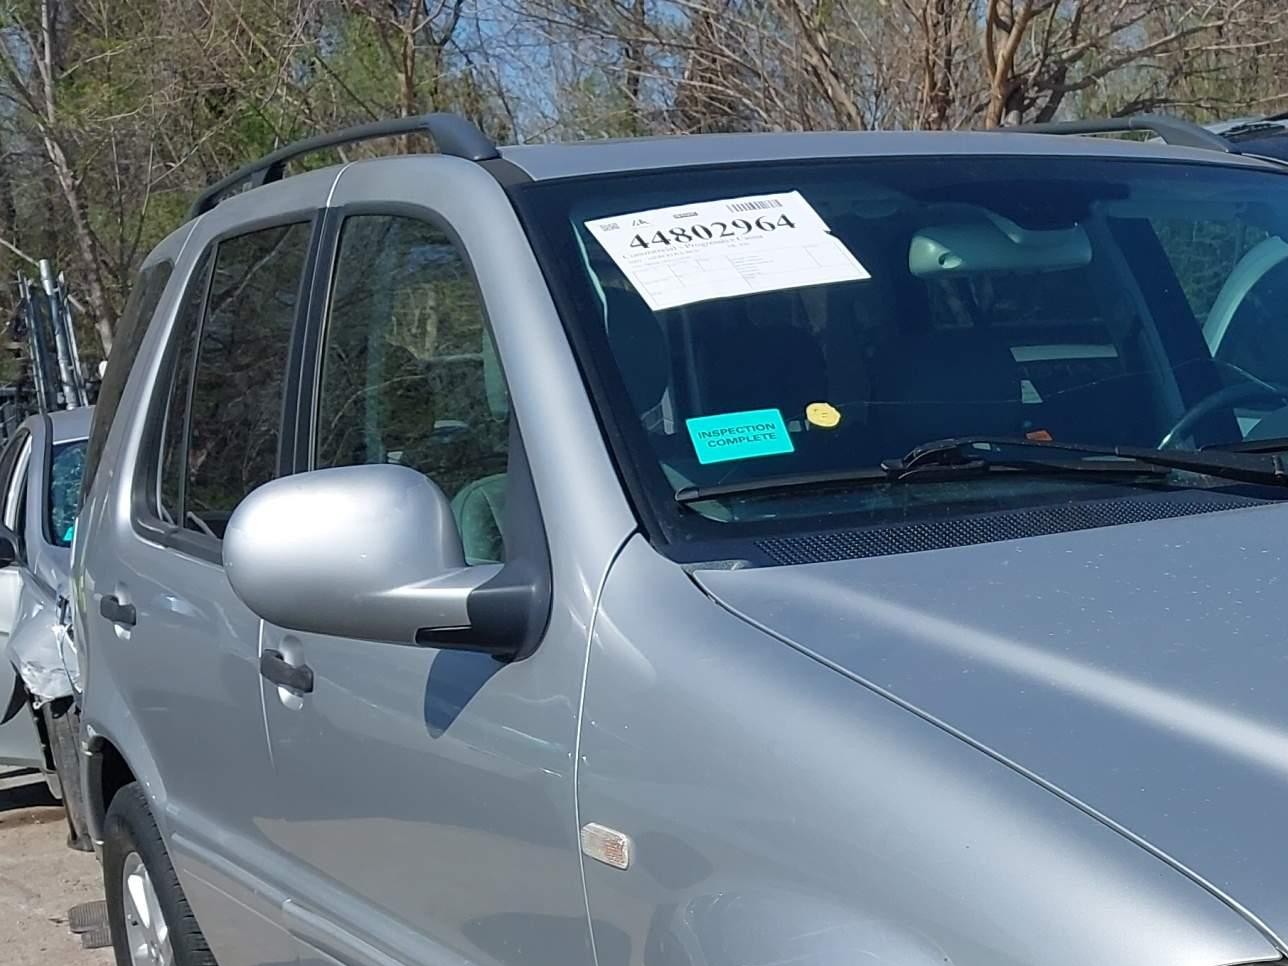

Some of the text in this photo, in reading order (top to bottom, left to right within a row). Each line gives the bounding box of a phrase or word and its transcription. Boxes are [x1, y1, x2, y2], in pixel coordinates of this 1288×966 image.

[629, 213, 796, 249] 44802964
[698, 422, 777, 440] INSPECTION
[707, 432, 777, 449] COMPLETE
